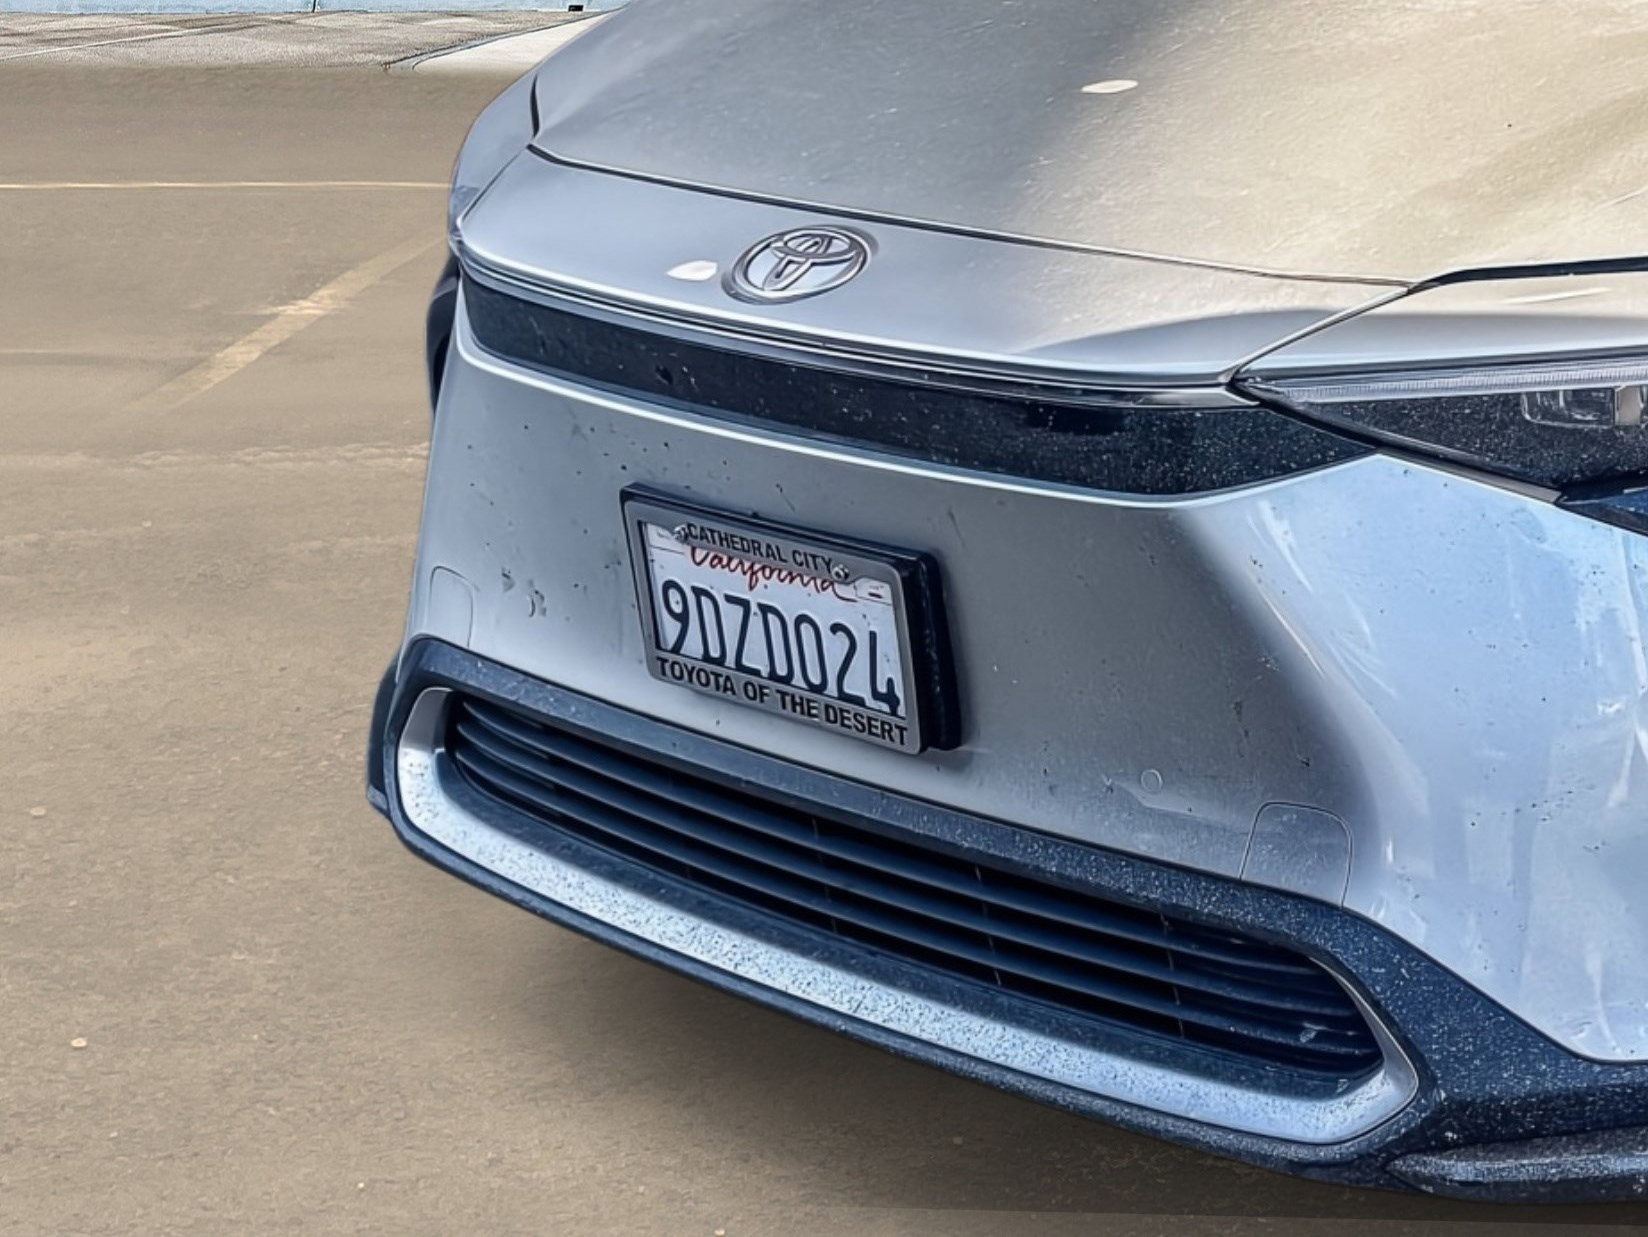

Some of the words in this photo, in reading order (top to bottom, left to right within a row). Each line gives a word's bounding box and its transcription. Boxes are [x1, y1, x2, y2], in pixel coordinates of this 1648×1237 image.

[686, 523, 788, 563] CATHEDRAL
[792, 549, 833, 575] CITY
[661, 578, 901, 715] 9DZD024
[656, 656, 736, 697] TOYOTA
[743, 680, 771, 704] OF
[776, 689, 819, 719] THE
[824, 704, 908, 747] DESERT
